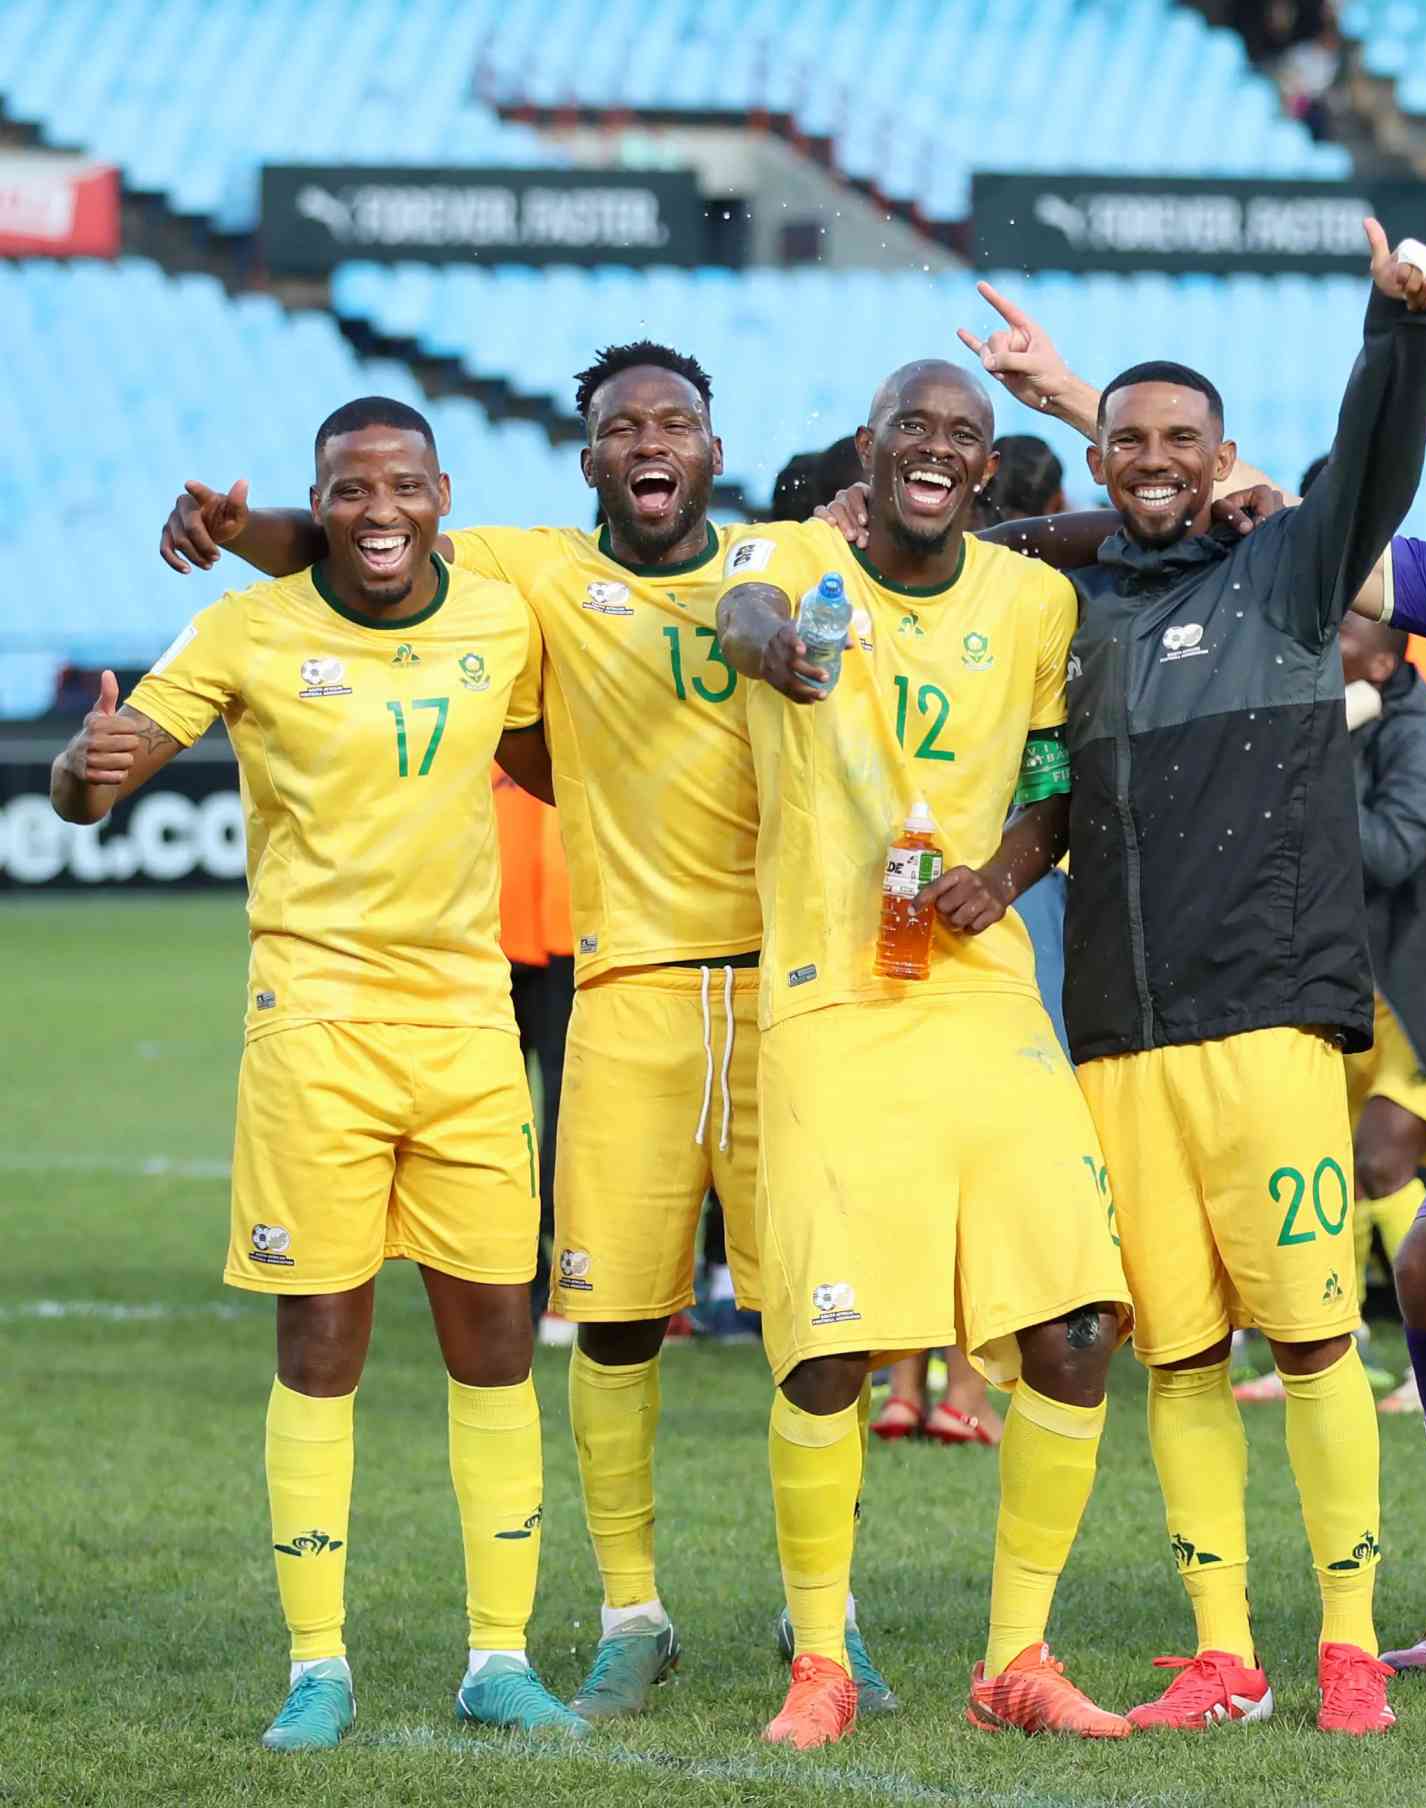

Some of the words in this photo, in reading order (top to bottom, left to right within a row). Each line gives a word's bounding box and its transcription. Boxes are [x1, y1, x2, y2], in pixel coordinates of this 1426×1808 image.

[663, 626, 737, 703] 13
[386, 696, 450, 778] 17
[894, 675, 955, 762] 12
[1268, 1156, 1348, 1247] 20
